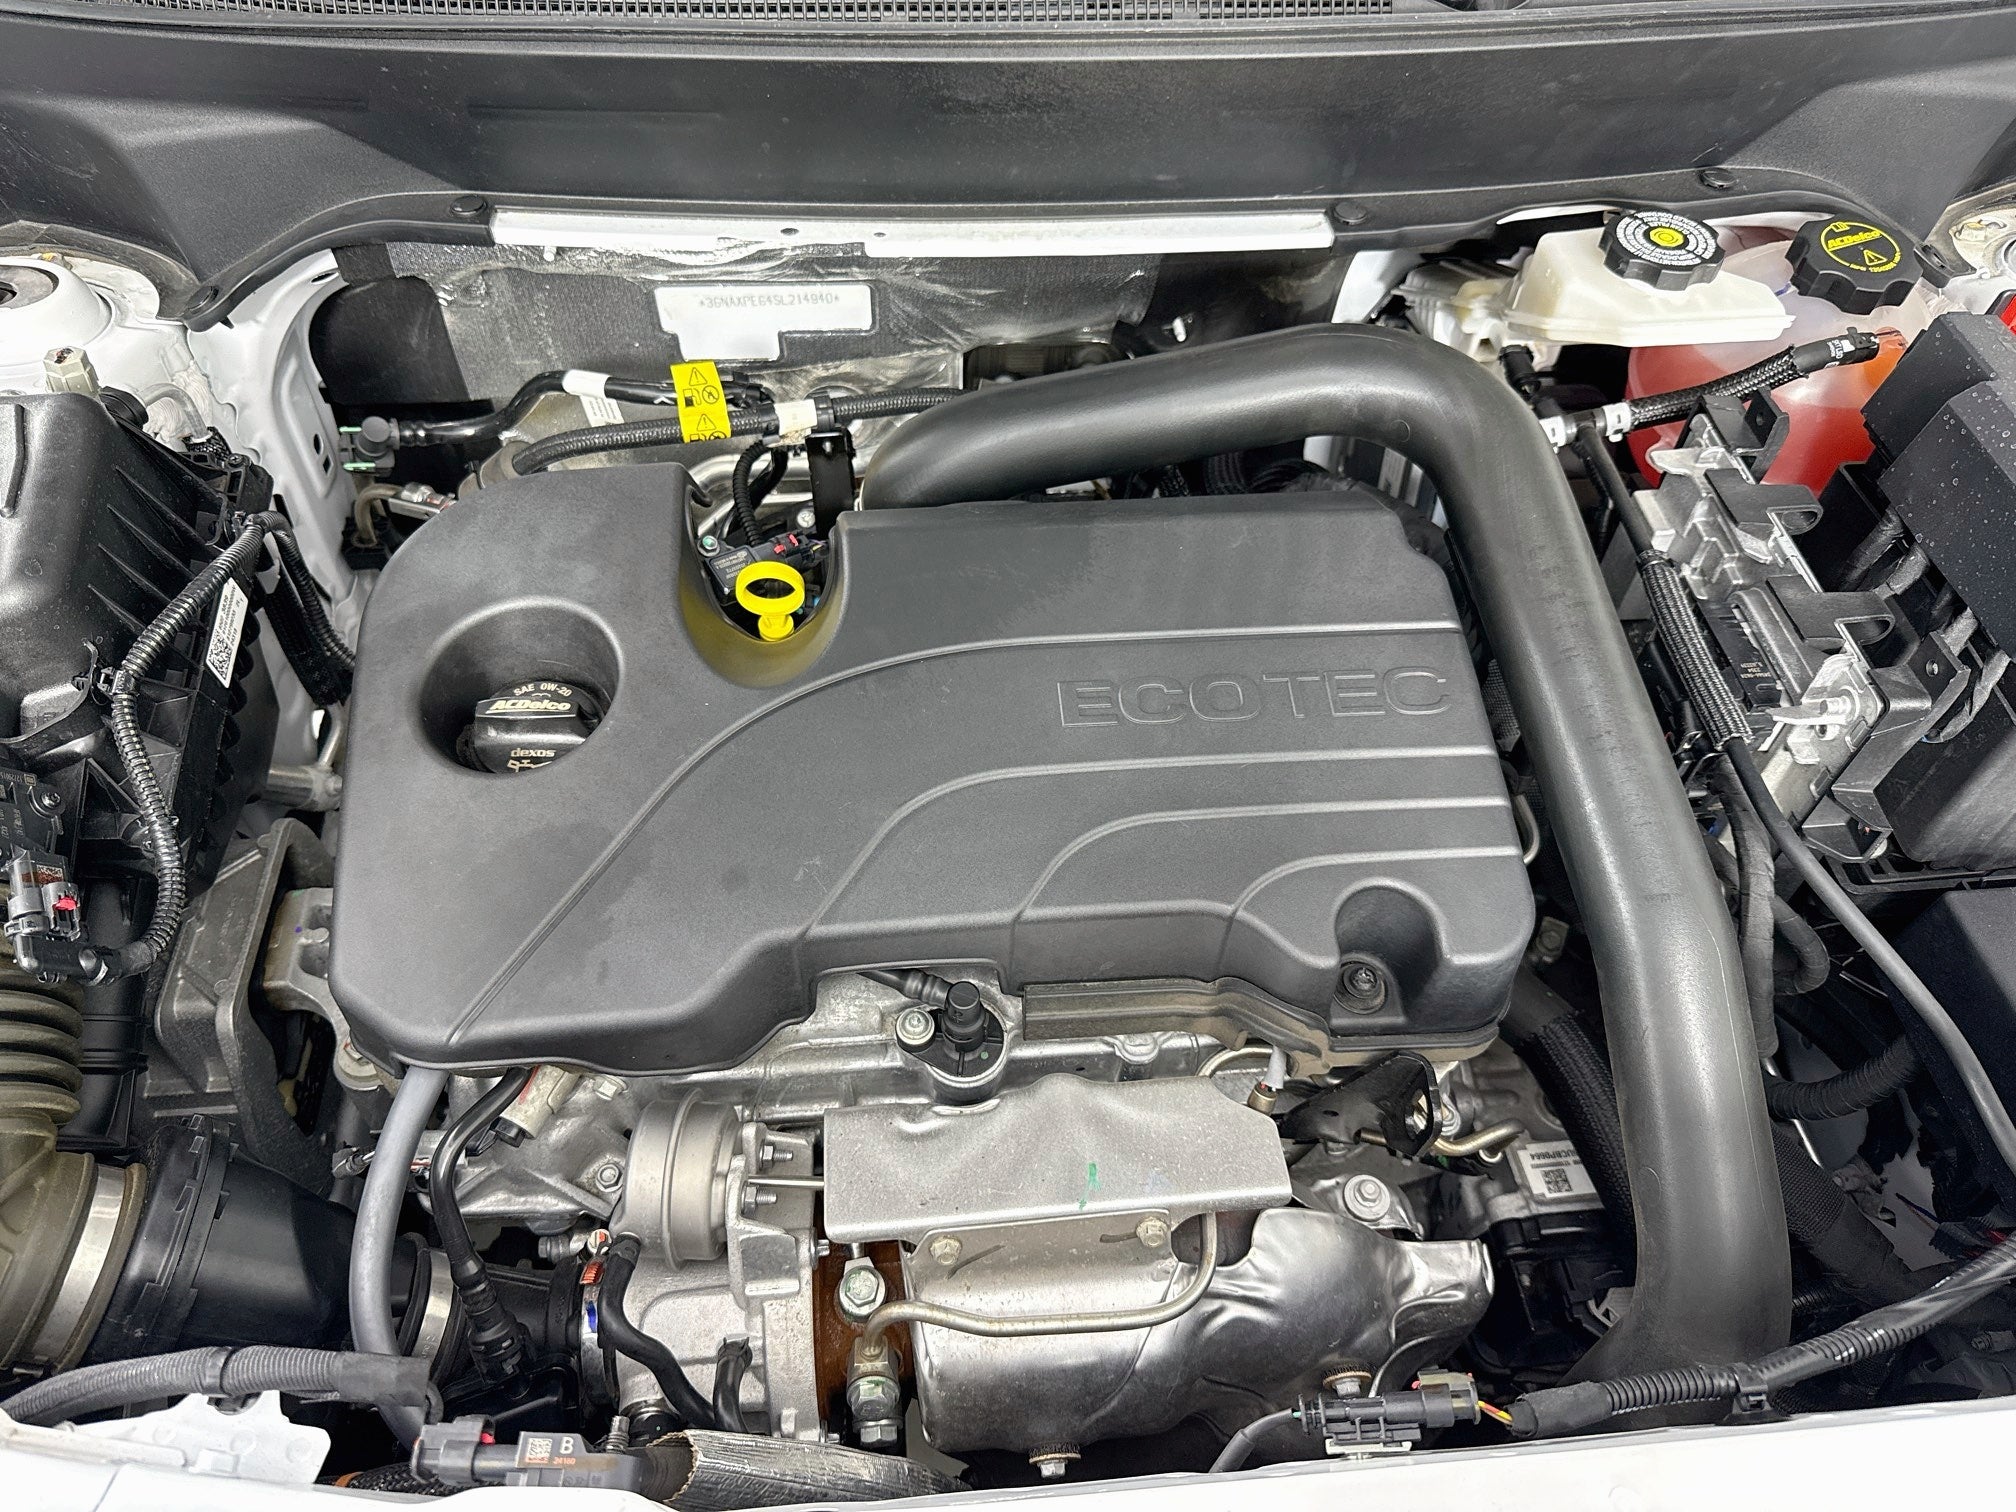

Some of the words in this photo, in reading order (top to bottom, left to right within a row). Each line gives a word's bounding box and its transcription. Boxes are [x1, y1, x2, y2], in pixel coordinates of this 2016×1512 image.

[1828, 230, 1881, 248] ACDelco
[513, 683, 535, 696] SAE
[540, 682, 573, 697] 0W-20
[1057, 666, 1450, 727] ECOTEC
[489, 700, 572, 712] ACDelco
[511, 748, 556, 757] dexos
[560, 1436, 574, 1455] B
